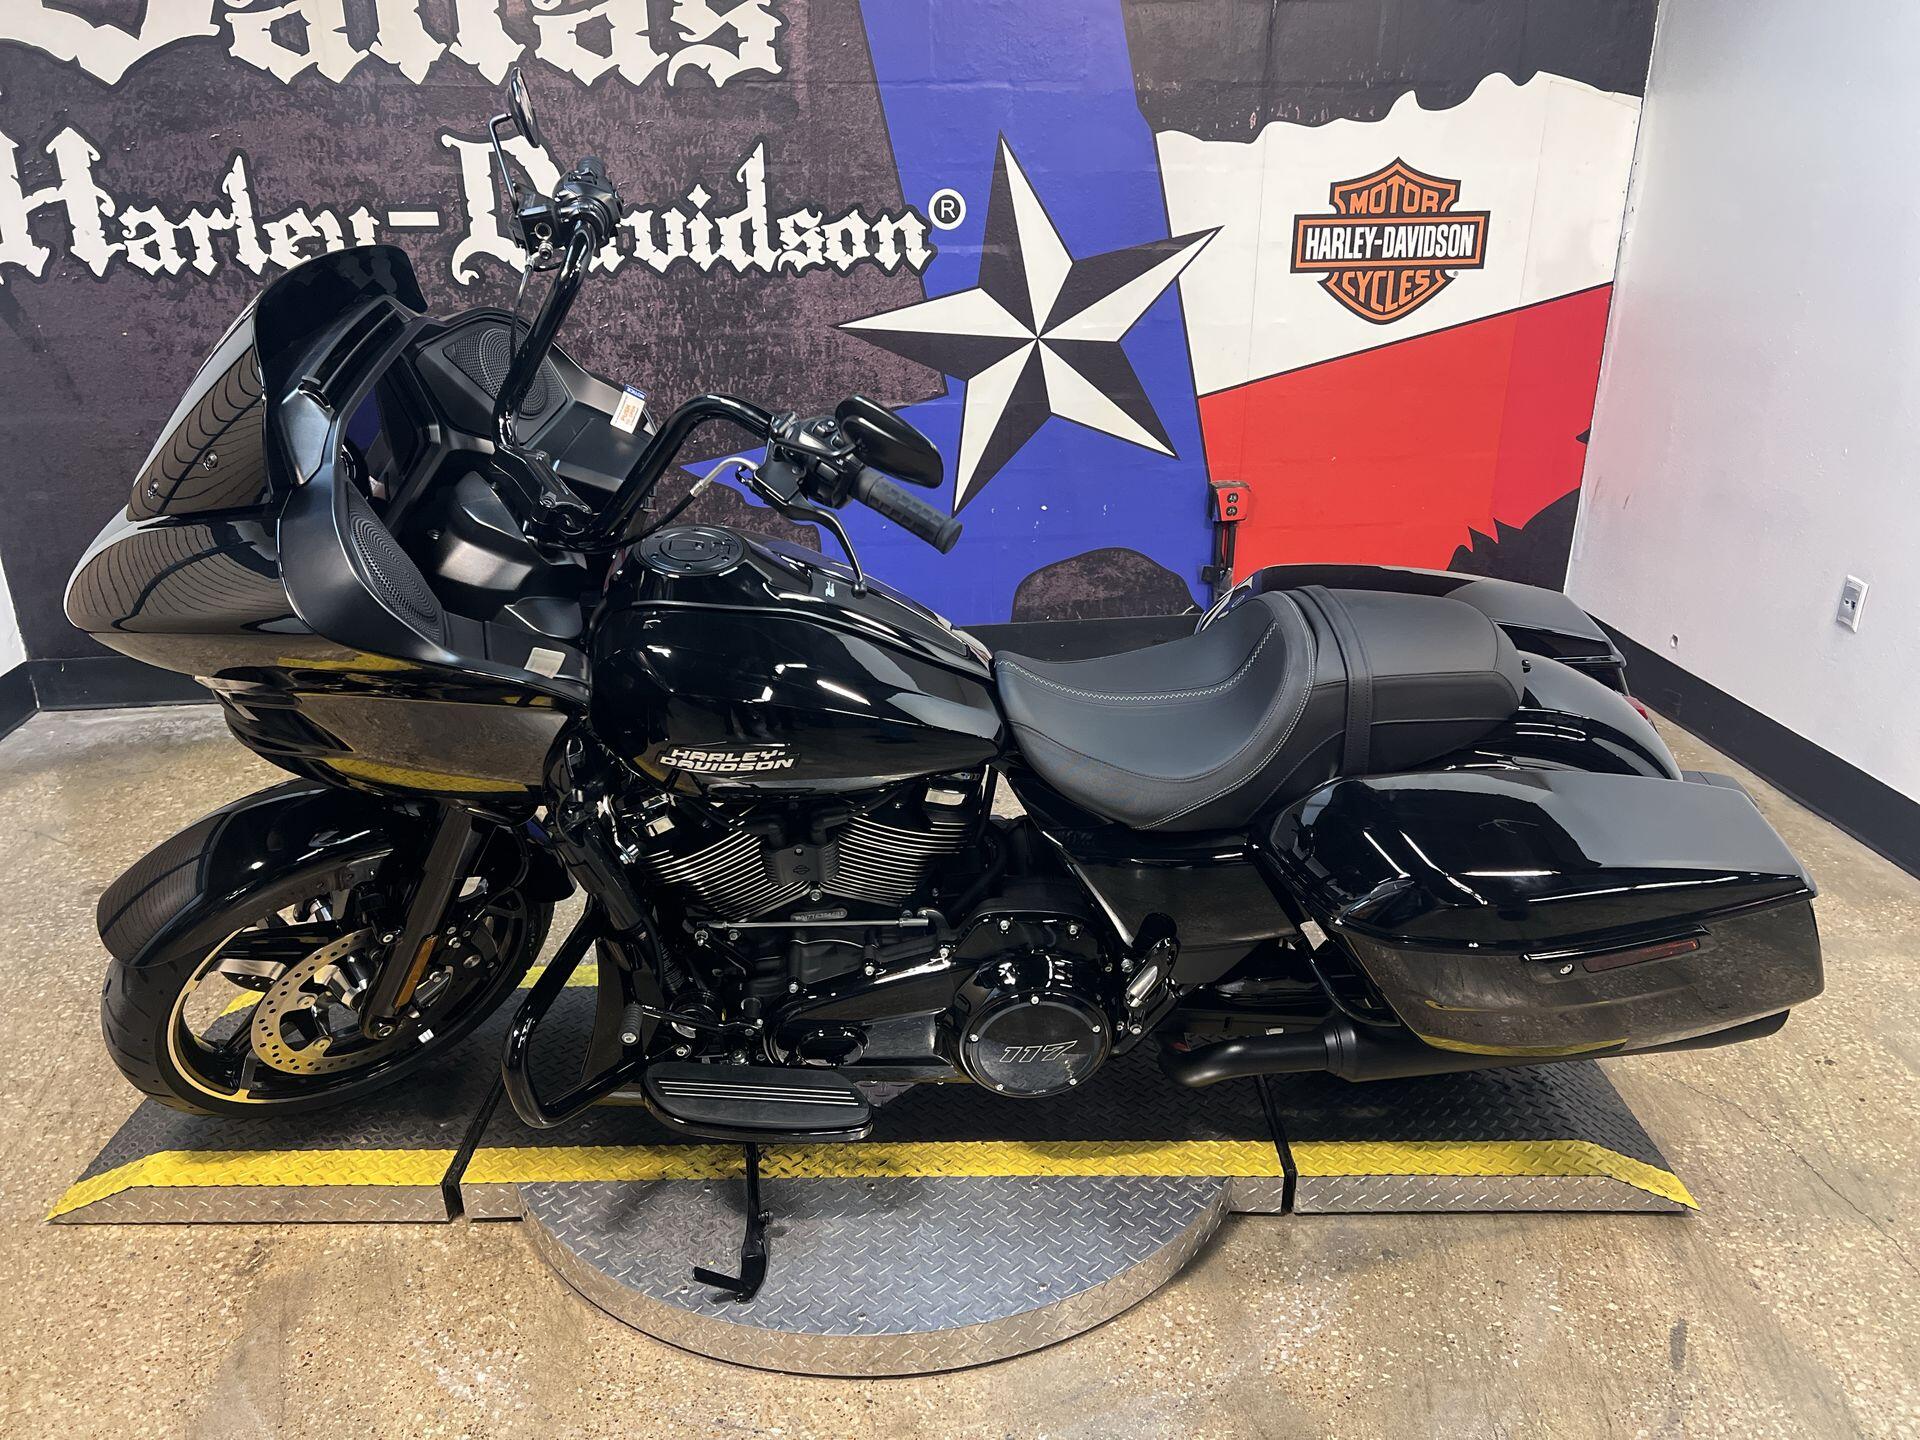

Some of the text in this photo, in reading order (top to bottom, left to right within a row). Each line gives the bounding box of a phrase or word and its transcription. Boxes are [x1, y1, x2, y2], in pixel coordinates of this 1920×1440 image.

[1349, 174, 1440, 214] MOTOR
[1304, 223, 1476, 260] HARLEY-DAVIDSON
[1342, 269, 1431, 313] CYCLES
[659, 756, 795, 772] DAVIDSON
[670, 749, 786, 763] HARLEY-
[999, 1039, 1079, 1063] 117
